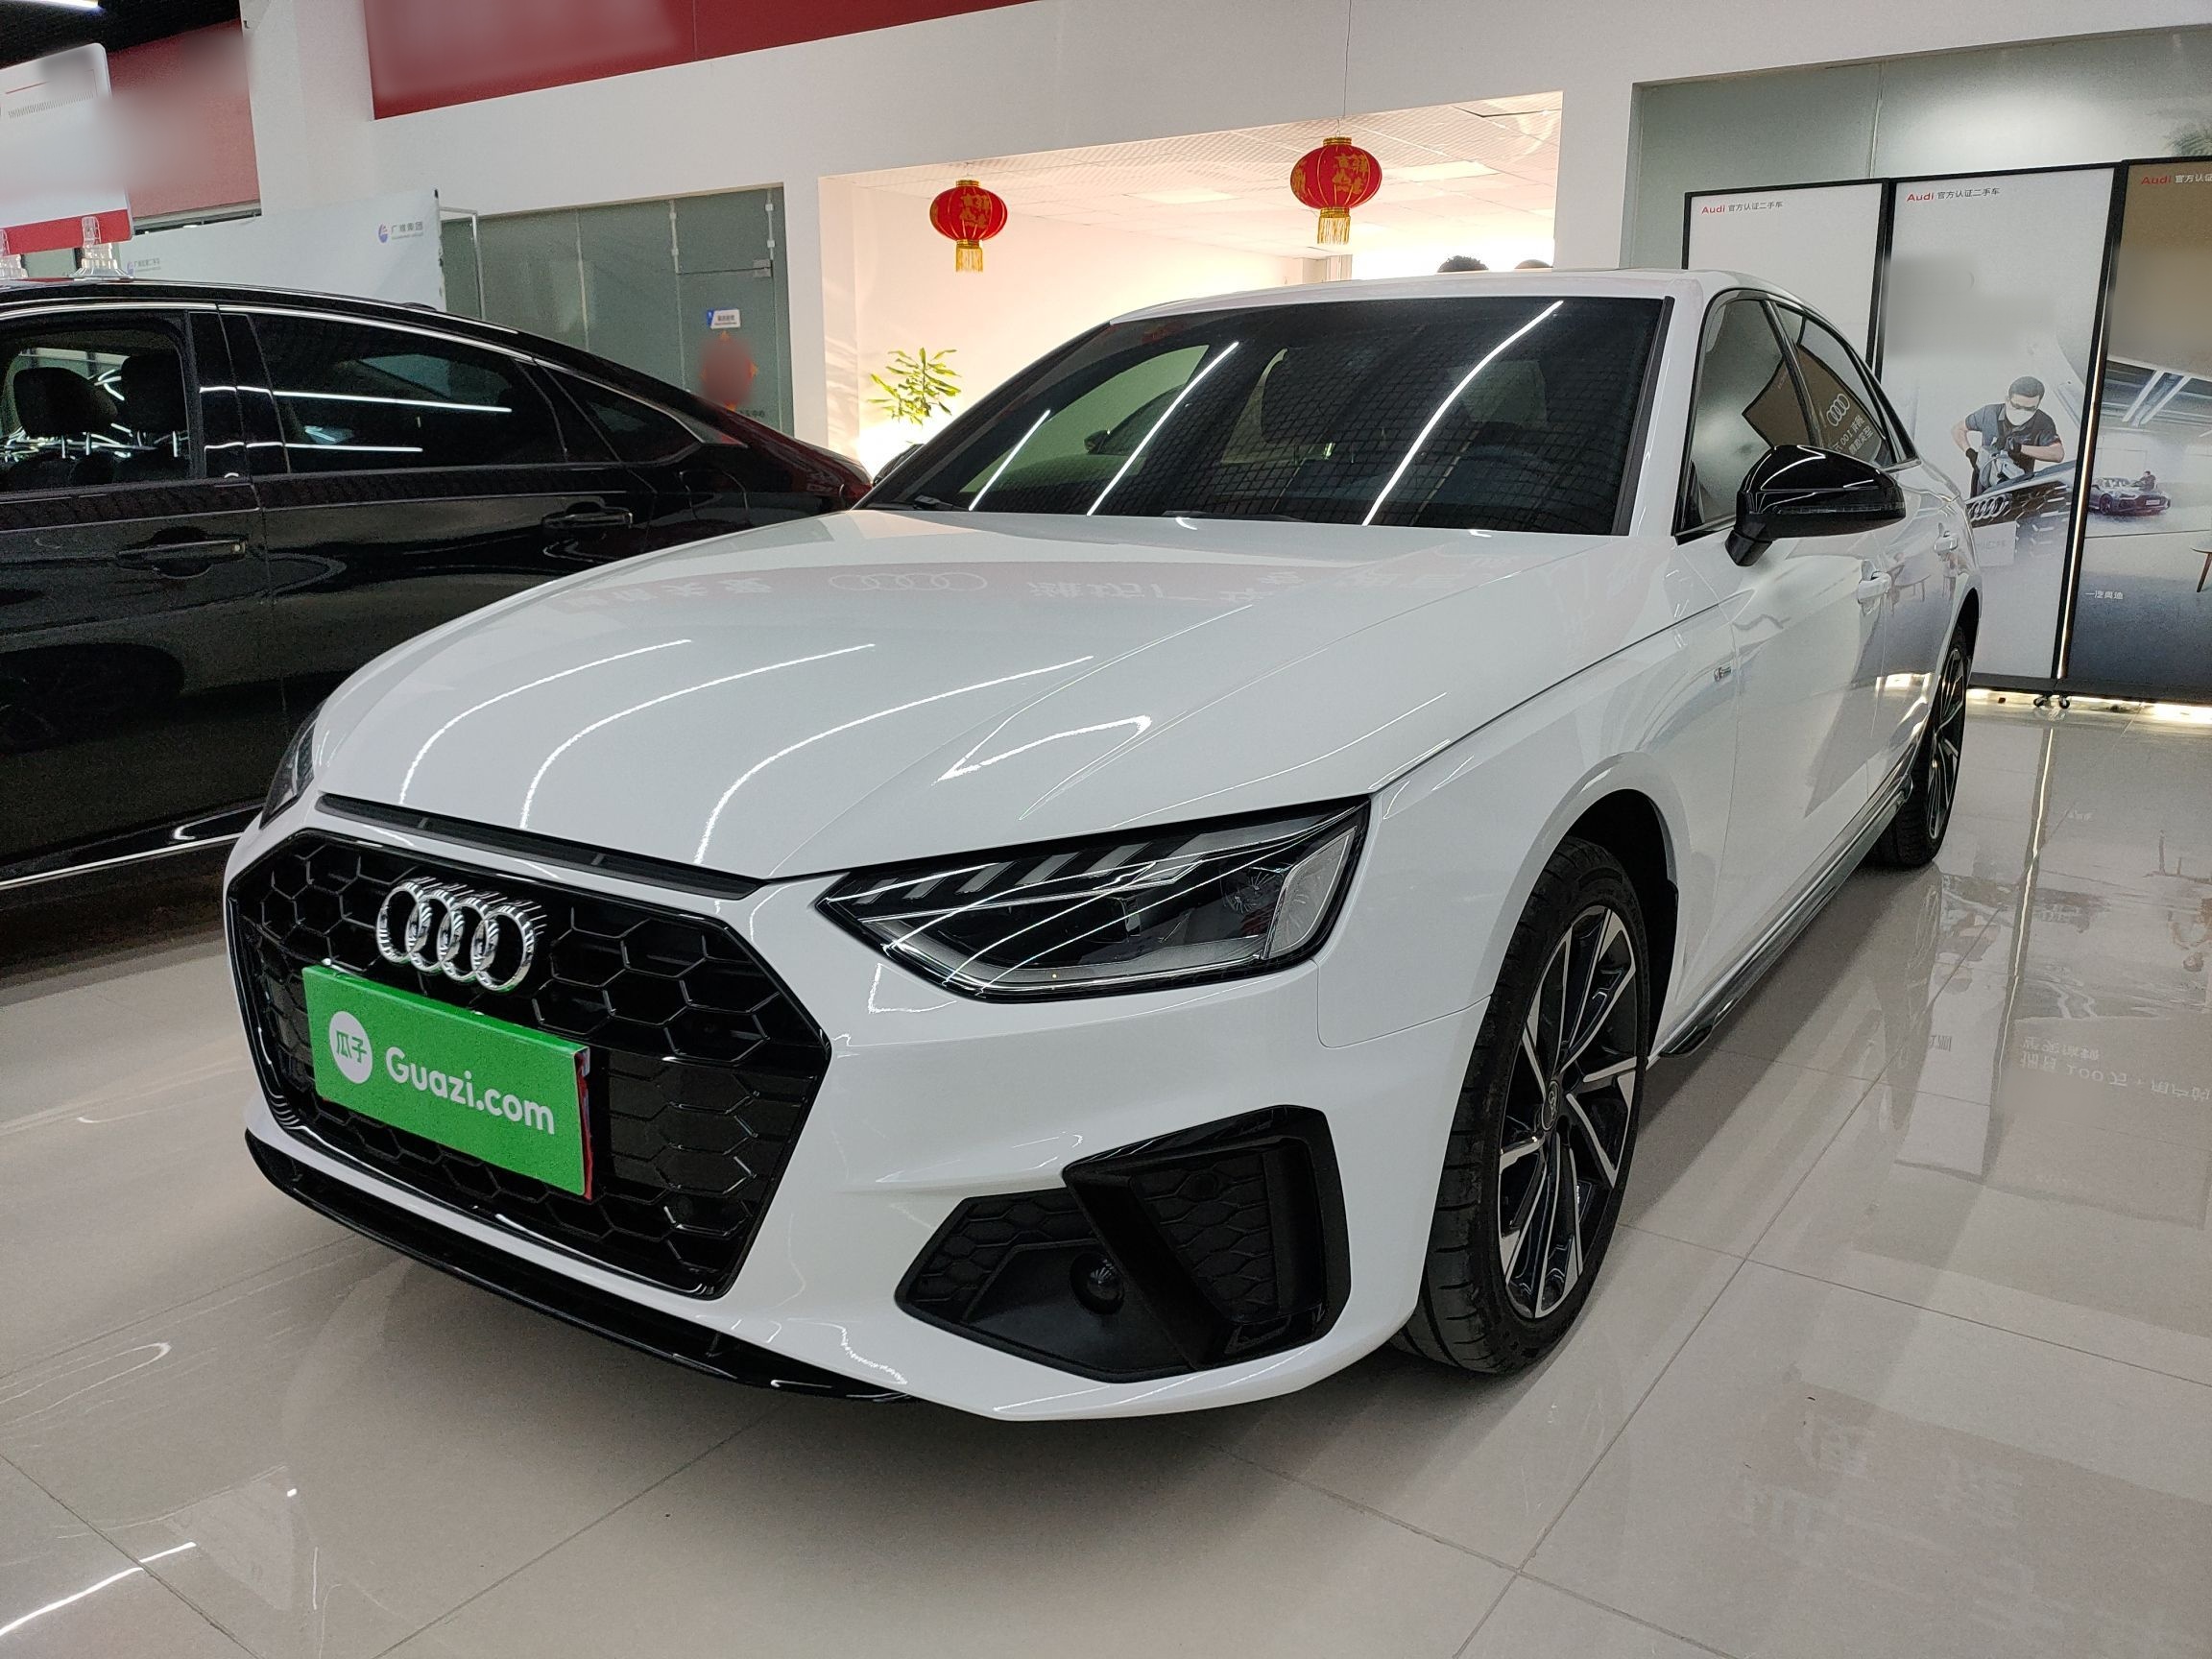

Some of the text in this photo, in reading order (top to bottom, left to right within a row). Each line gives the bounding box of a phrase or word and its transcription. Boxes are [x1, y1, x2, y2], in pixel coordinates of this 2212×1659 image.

[2141, 175, 2172, 184] Audi
[1907, 188, 2000, 202] Audi 官方认证二手车
[1701, 202, 1783, 214] Audi 官方认证二手车
[336, 1031, 367, 1064] 瓜子
[386, 1046, 555, 1136] Guazi.com
